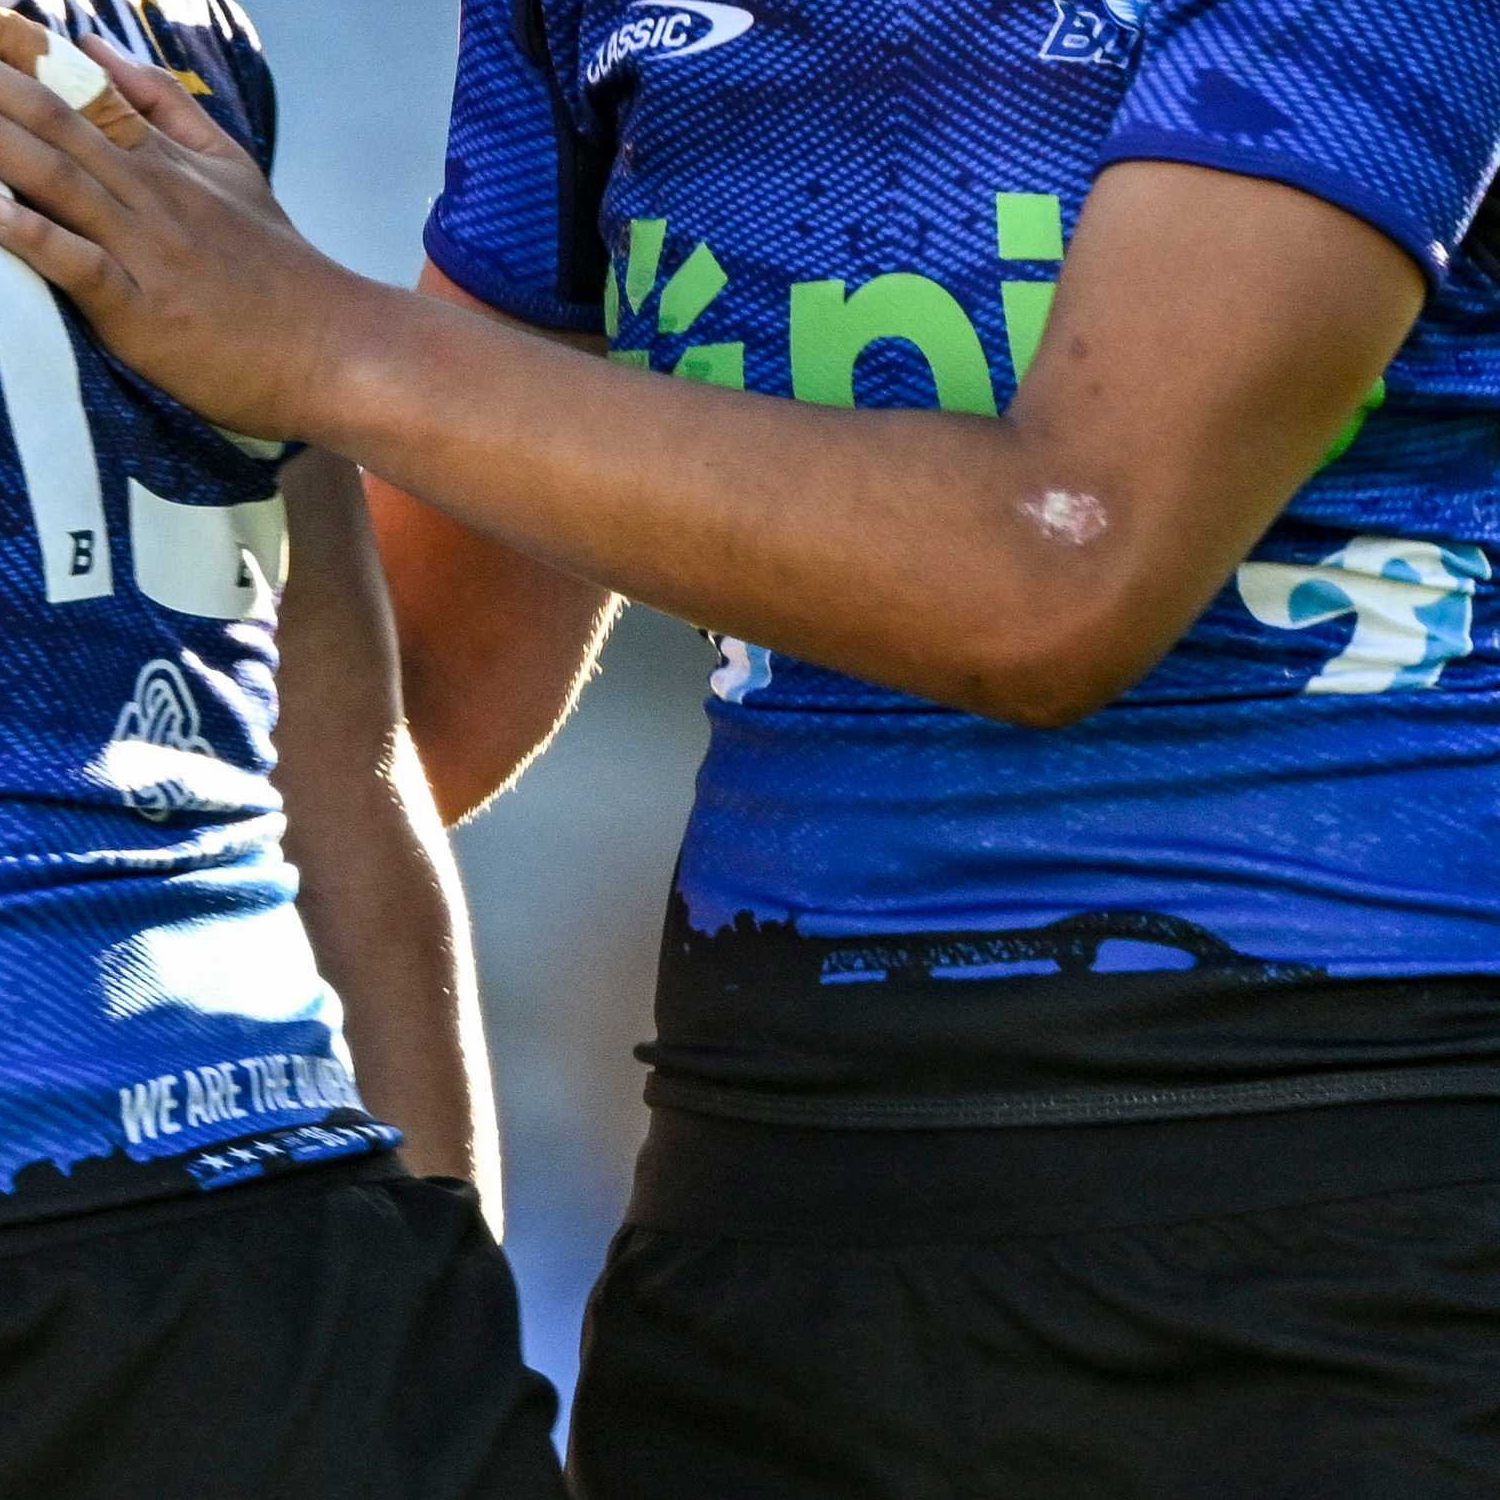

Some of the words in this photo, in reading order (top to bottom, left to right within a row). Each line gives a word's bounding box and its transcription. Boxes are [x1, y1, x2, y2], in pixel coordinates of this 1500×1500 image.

[586, 12, 692, 85] CLASSIC
[119, 1074, 183, 1145] WE
[182, 1061, 248, 1128] ARE
[238, 1054, 302, 1114] THE
